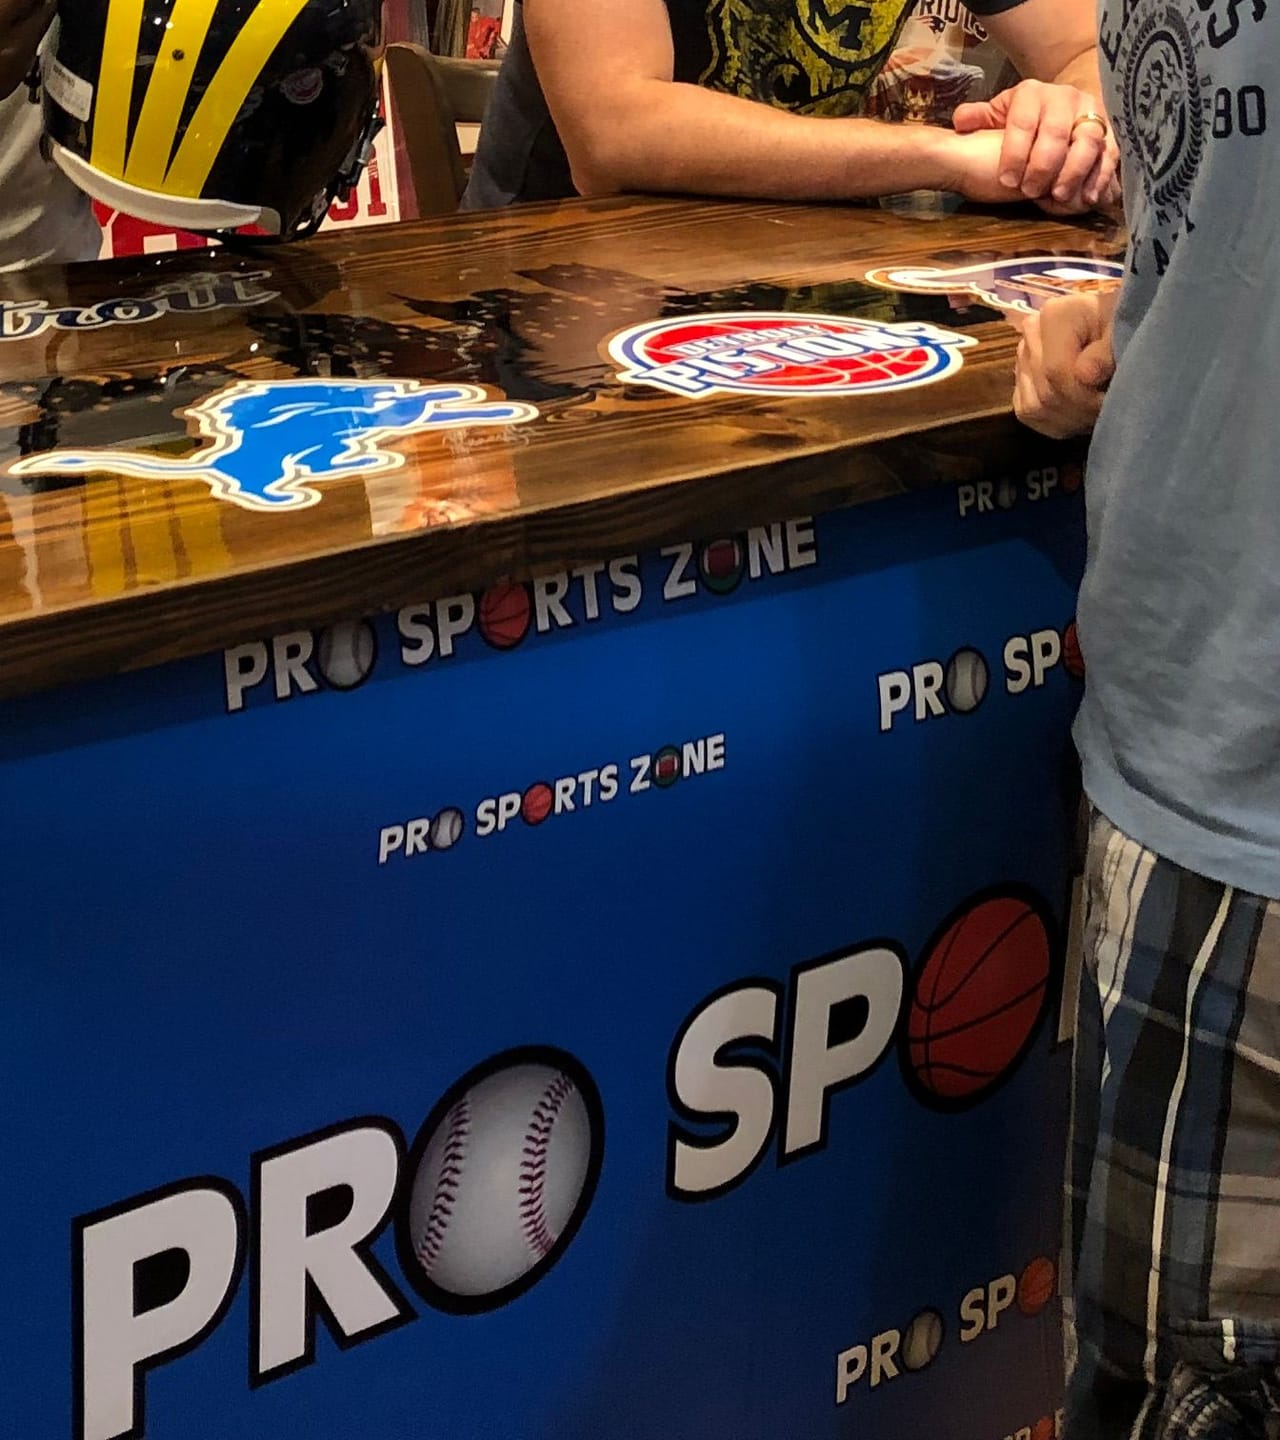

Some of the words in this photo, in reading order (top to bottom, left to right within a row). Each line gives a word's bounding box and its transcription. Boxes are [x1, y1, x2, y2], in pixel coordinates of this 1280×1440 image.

[1212, 84, 1267, 140] 80
[632, 323, 968, 393] PISTONS
[668, 324, 826, 357] DETROIT
[957, 476, 1018, 518] PRO
[224, 616, 379, 713] PRO
[396, 557, 642, 668] SPORTS
[661, 513, 819, 602] ZONE
[877, 646, 988, 732] PRO
[377, 806, 465, 865] PRO
[475, 764, 619, 839] SPORTS
[628, 732, 727, 797] ZONE
[74, 1044, 606, 1440] PRO
[835, 1305, 946, 1406] PRO
